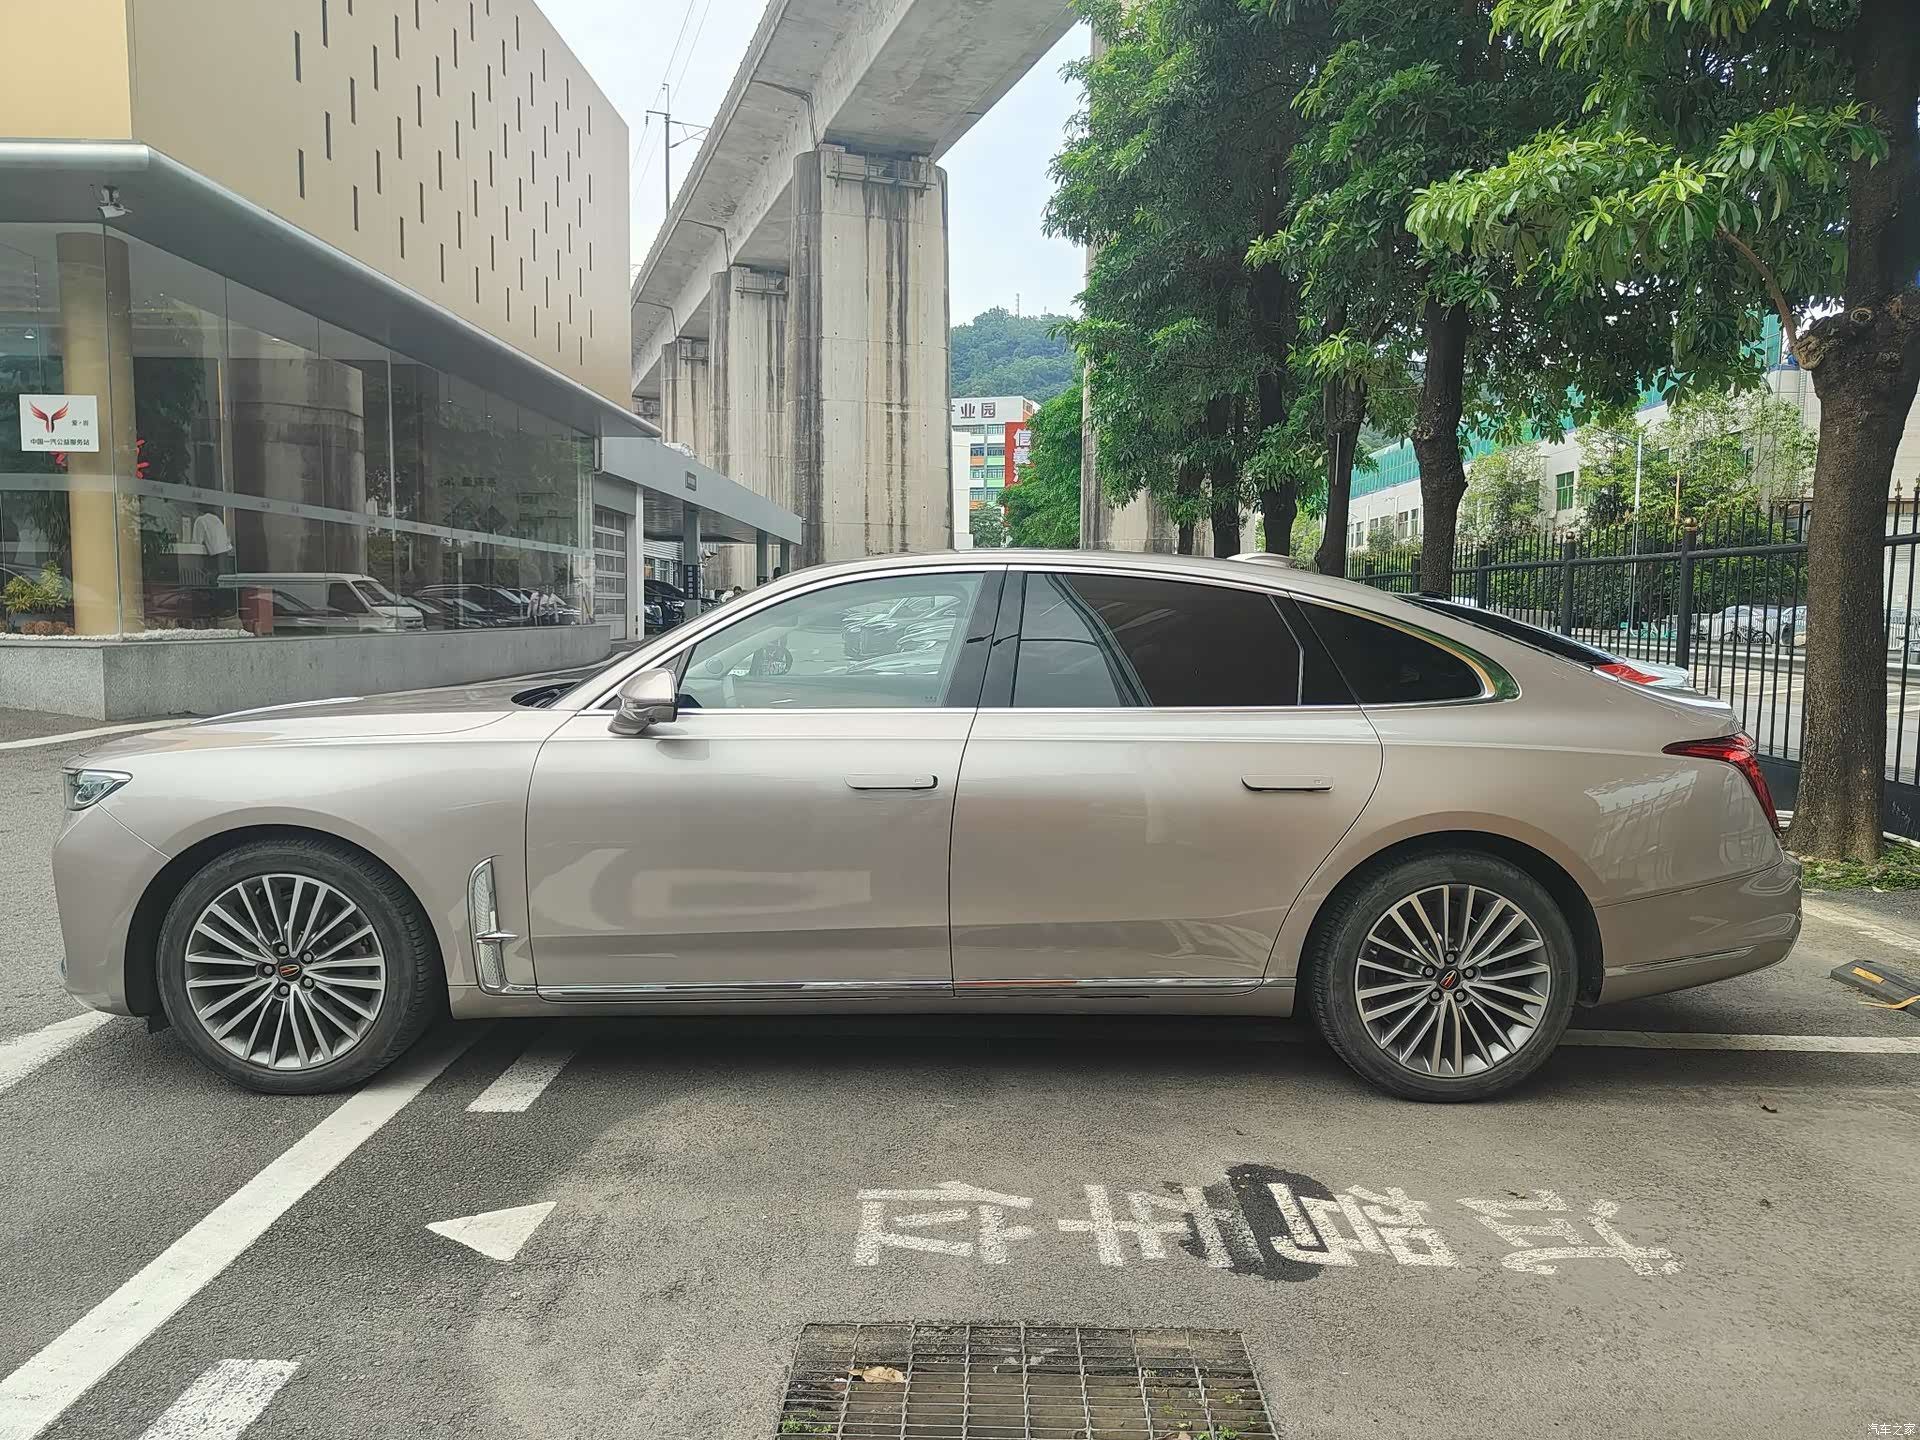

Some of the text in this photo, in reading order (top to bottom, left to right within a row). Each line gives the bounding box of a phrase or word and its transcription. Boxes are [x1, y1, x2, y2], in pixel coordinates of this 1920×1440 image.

[30, 438, 90, 446] 中国一汽公益服务站
